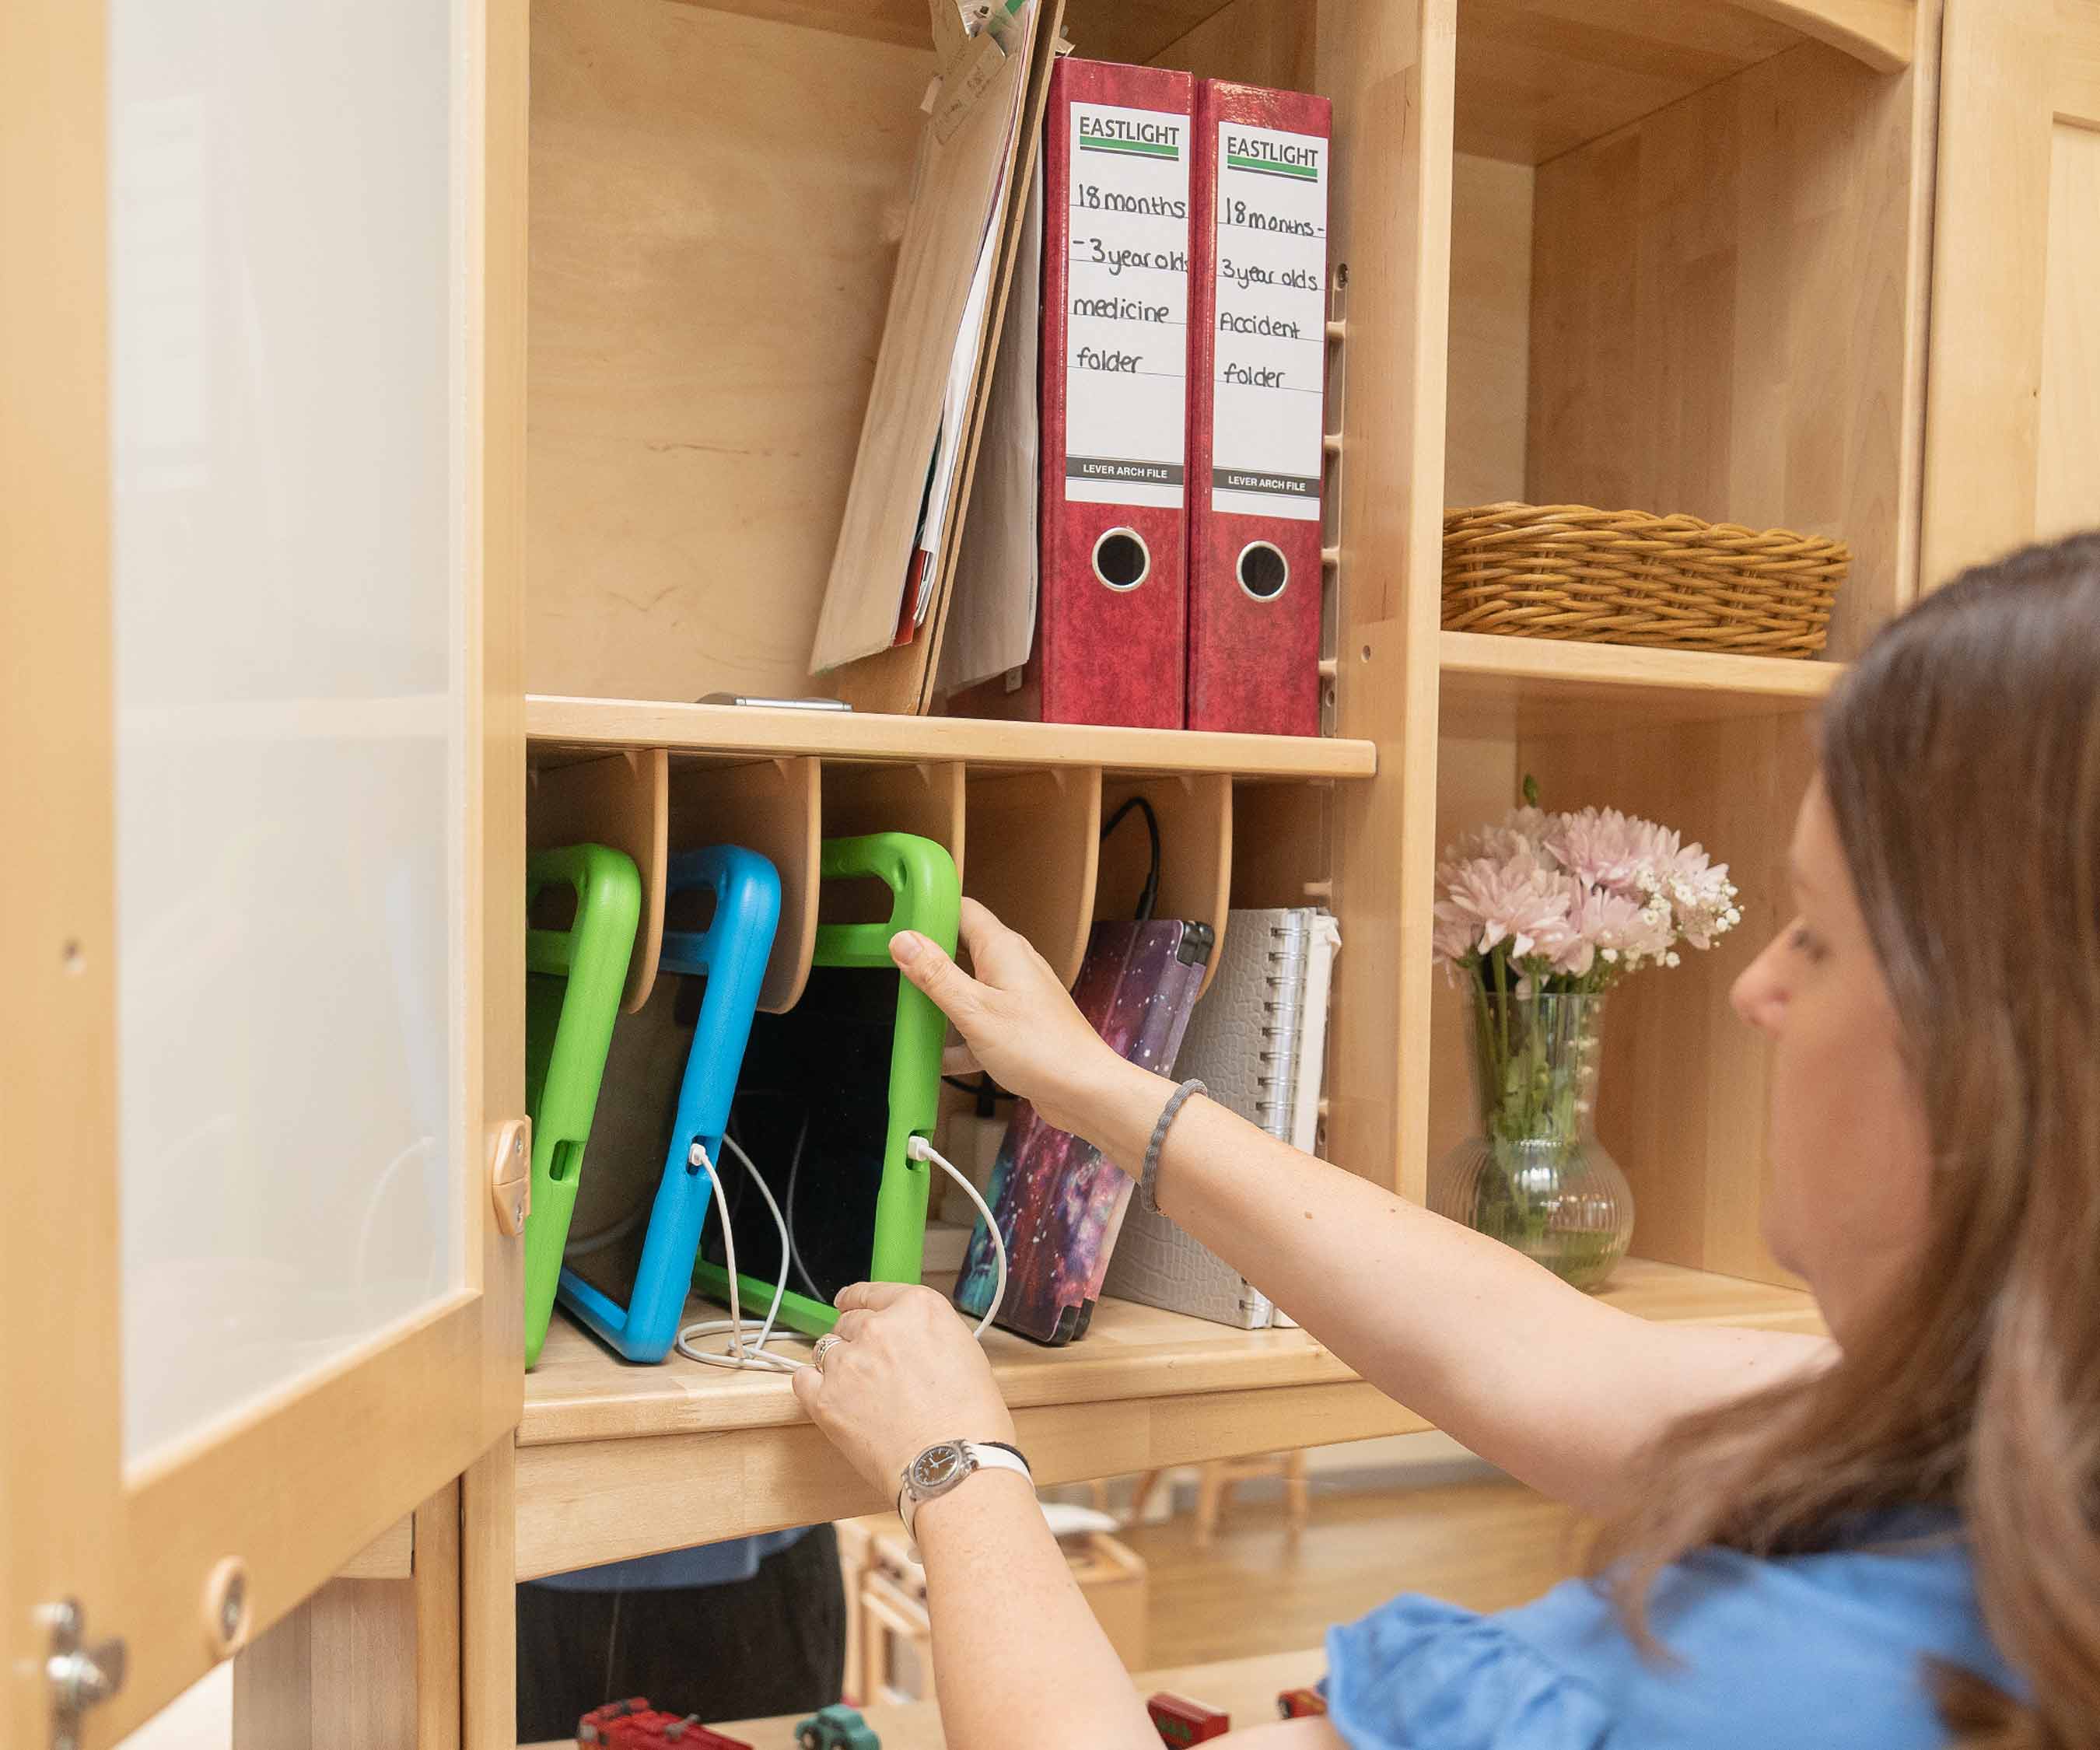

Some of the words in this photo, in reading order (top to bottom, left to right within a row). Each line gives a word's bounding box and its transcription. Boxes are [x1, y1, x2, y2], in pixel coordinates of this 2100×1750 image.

[1080, 117, 1179, 145] EASTLIGHT
[1227, 136, 1318, 167] EASTLIGHT
[1108, 250, 1152, 276] year
[1237, 265, 1276, 289] year
[1281, 269, 1318, 291] olds
[1073, 297, 1170, 324] medicine
[1220, 312, 1300, 339] Accident
[1076, 346, 1143, 373] folder
[1223, 362, 1286, 388] folder
[1083, 464, 1115, 475] LEVER
[1116, 466, 1145, 478] ARCH
[1146, 468, 1167, 479] FILE
[1228, 475, 1258, 488] LEVER
[1258, 478, 1286, 490] ARCH
[1286, 481, 1306, 492] FILE
